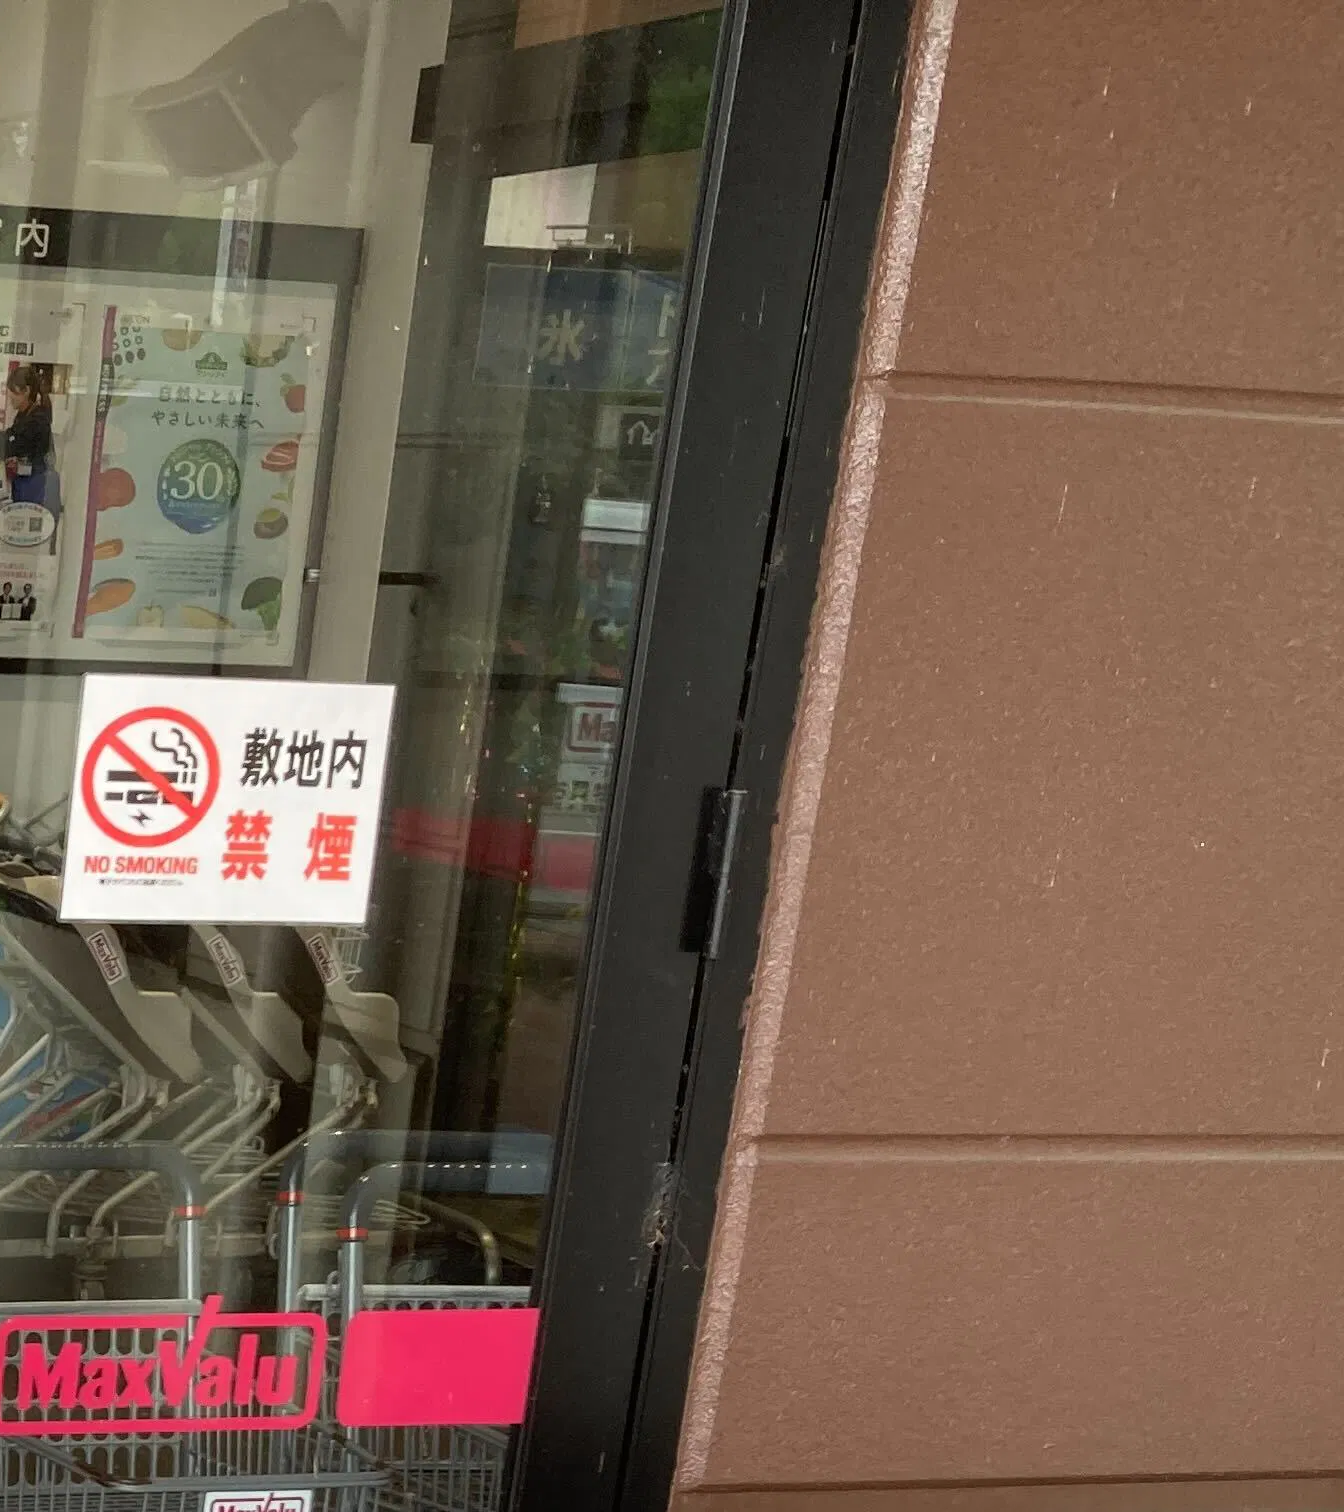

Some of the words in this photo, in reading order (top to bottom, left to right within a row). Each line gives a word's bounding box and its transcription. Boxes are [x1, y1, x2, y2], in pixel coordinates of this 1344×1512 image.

[152, 411, 264, 430] やさしい未来へ
[170, 461, 223, 500] 30
[240, 727, 368, 789] 敷地内
[84, 855, 110, 874] NO
[114, 856, 199, 875] SMOKING
[220, 809, 358, 881] 禁煙
[17, 1294, 298, 1411] MaxValu
